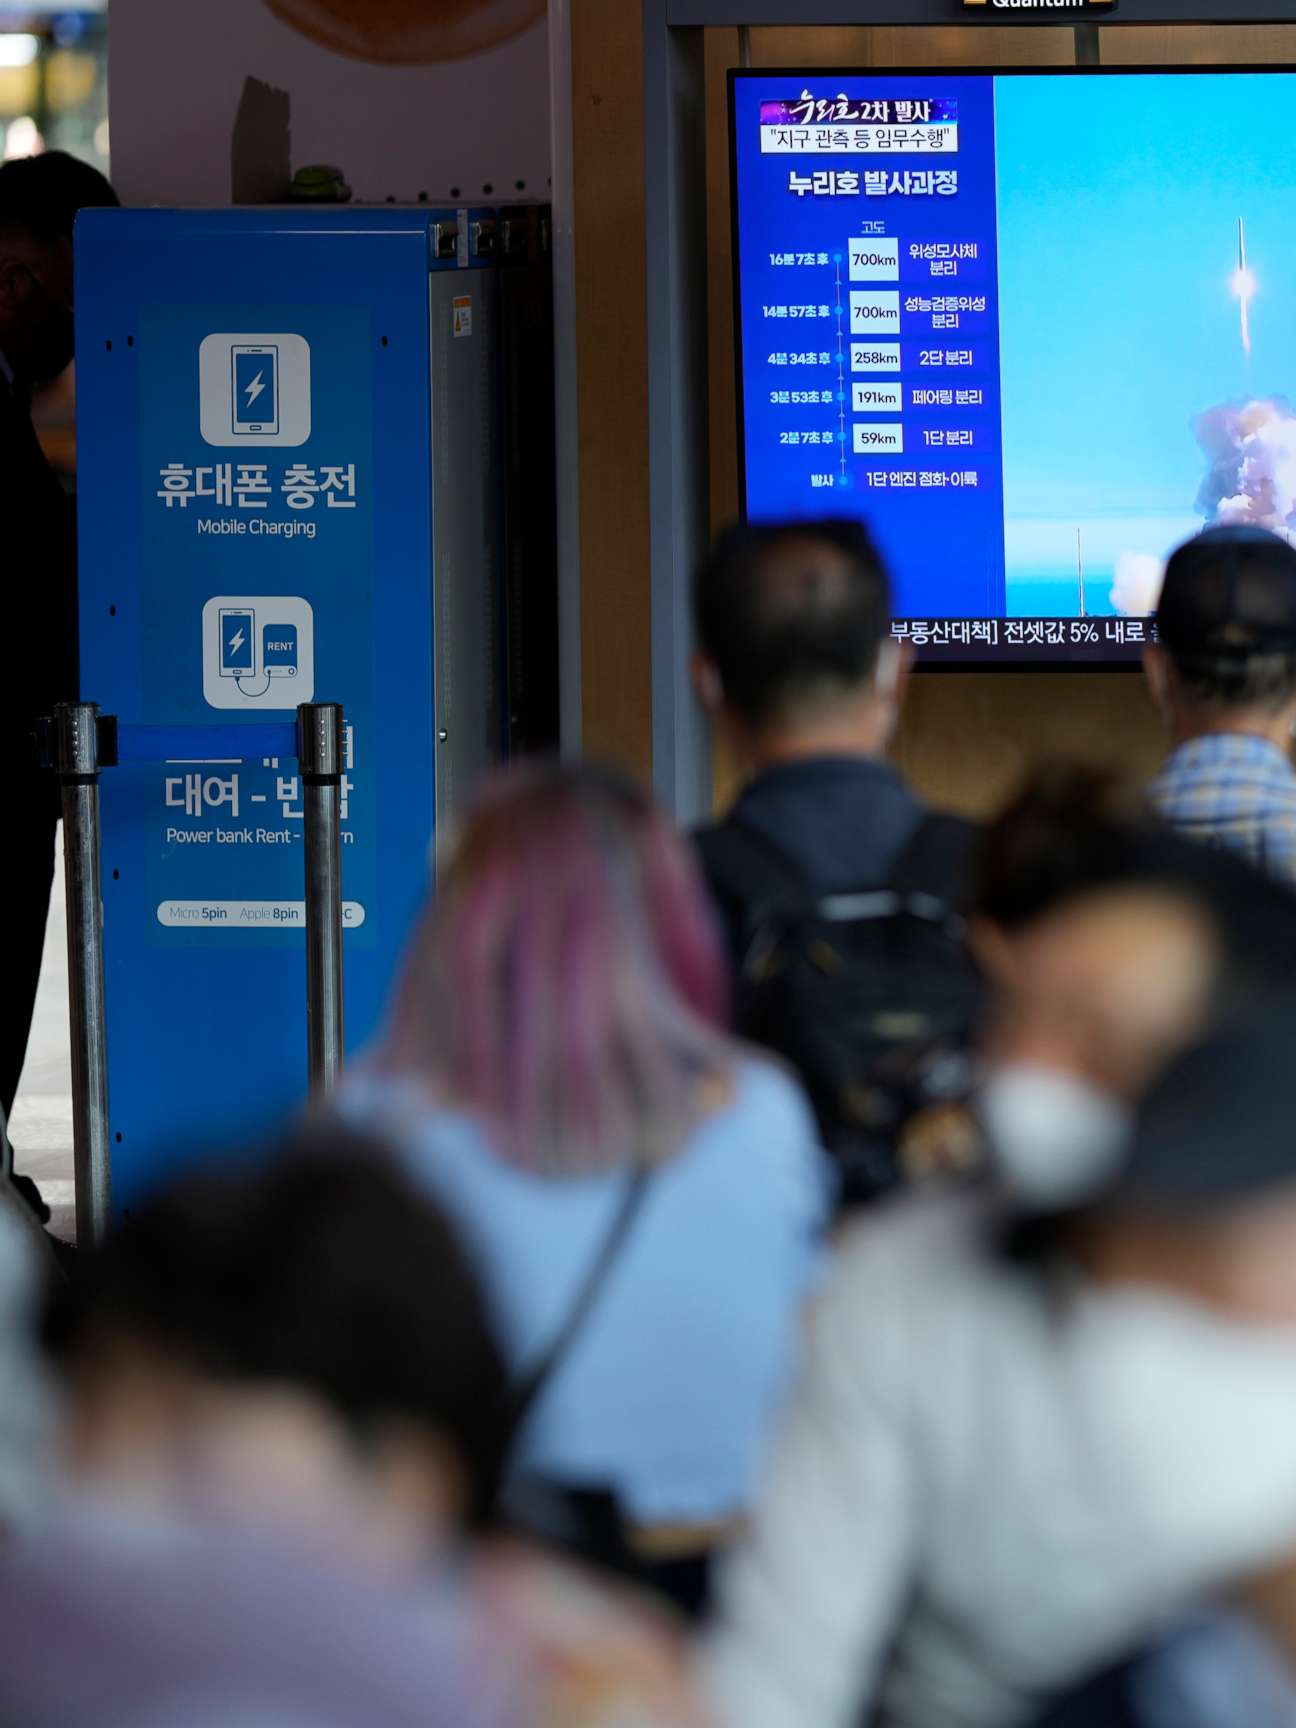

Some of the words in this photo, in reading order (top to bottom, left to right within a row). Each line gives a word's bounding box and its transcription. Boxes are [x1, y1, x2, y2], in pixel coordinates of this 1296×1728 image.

[790, 89, 860, 126] 누리호
[861, 101, 889, 122] 2차
[895, 101, 931, 122] 발사
[771, 127, 811, 150] "지구
[815, 129, 849, 149] 관측
[854, 130, 870, 149] 등
[875, 127, 949, 149] 임무수행"
[789, 171, 860, 196] 누리호
[865, 170, 958, 196] 발사과정
[861, 221, 886, 234] 고도
[909, 243, 977, 259] 위성모사체
[853, 254, 896, 268] 700km
[930, 261, 957, 276] 분리
[905, 296, 986, 312] 성능검증위성
[854, 307, 898, 321] 700km
[932, 314, 959, 329] 분리
[854, 352, 898, 365] 258km
[919, 351, 944, 366] 2단
[945, 350, 973, 366] 분리
[857, 391, 897, 404] 191km
[912, 389, 953, 405] 페어링
[955, 389, 982, 405] 분리
[861, 432, 897, 445] 59km
[923, 430, 944, 446] 1단
[945, 430, 973, 446] 분리
[157, 463, 272, 508] 휴대폰
[281, 463, 357, 510] 충전
[811, 474, 834, 488] 발사
[866, 472, 887, 488] 1단
[889, 471, 917, 488] 엔진
[197, 519, 246, 535] Mobile
[249, 519, 317, 539] Charging
[889, 620, 998, 646] 부동산대책]
[1004, 620, 1065, 646] 전셋값
[1070, 622, 1100, 644] 5%
[1105, 620, 1146, 645] 내로
[267, 641, 294, 651] RENT
[165, 773, 239, 817] 대여
[167, 828, 213, 844] Power
[216, 827, 253, 844] bank
[256, 828, 291, 844] Rent
[169, 907, 200, 920] Micro
[202, 907, 228, 924] 5pin
[240, 907, 271, 924] Apple
[273, 907, 299, 924] 8pin
